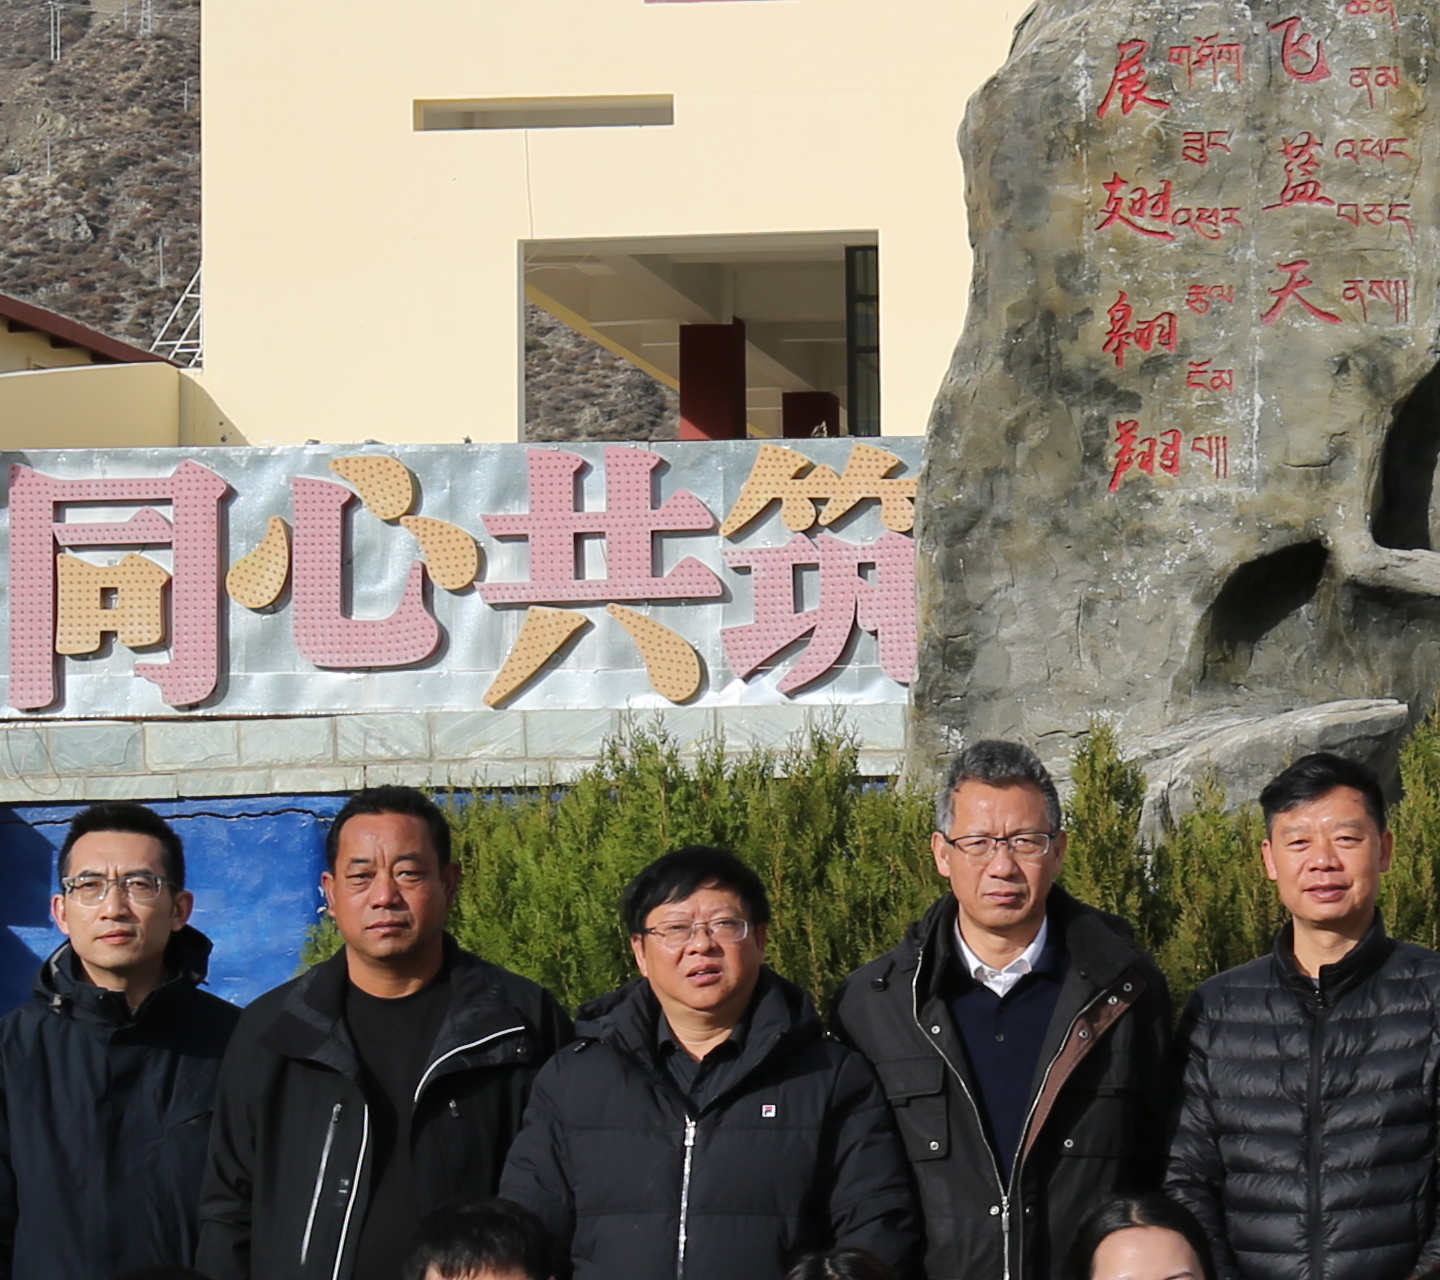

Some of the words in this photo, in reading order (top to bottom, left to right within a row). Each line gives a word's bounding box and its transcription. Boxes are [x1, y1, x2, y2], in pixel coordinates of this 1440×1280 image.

[1095, 39, 1182, 493] 展翅翱翔
[9, 443, 918, 709] 同心共筑
